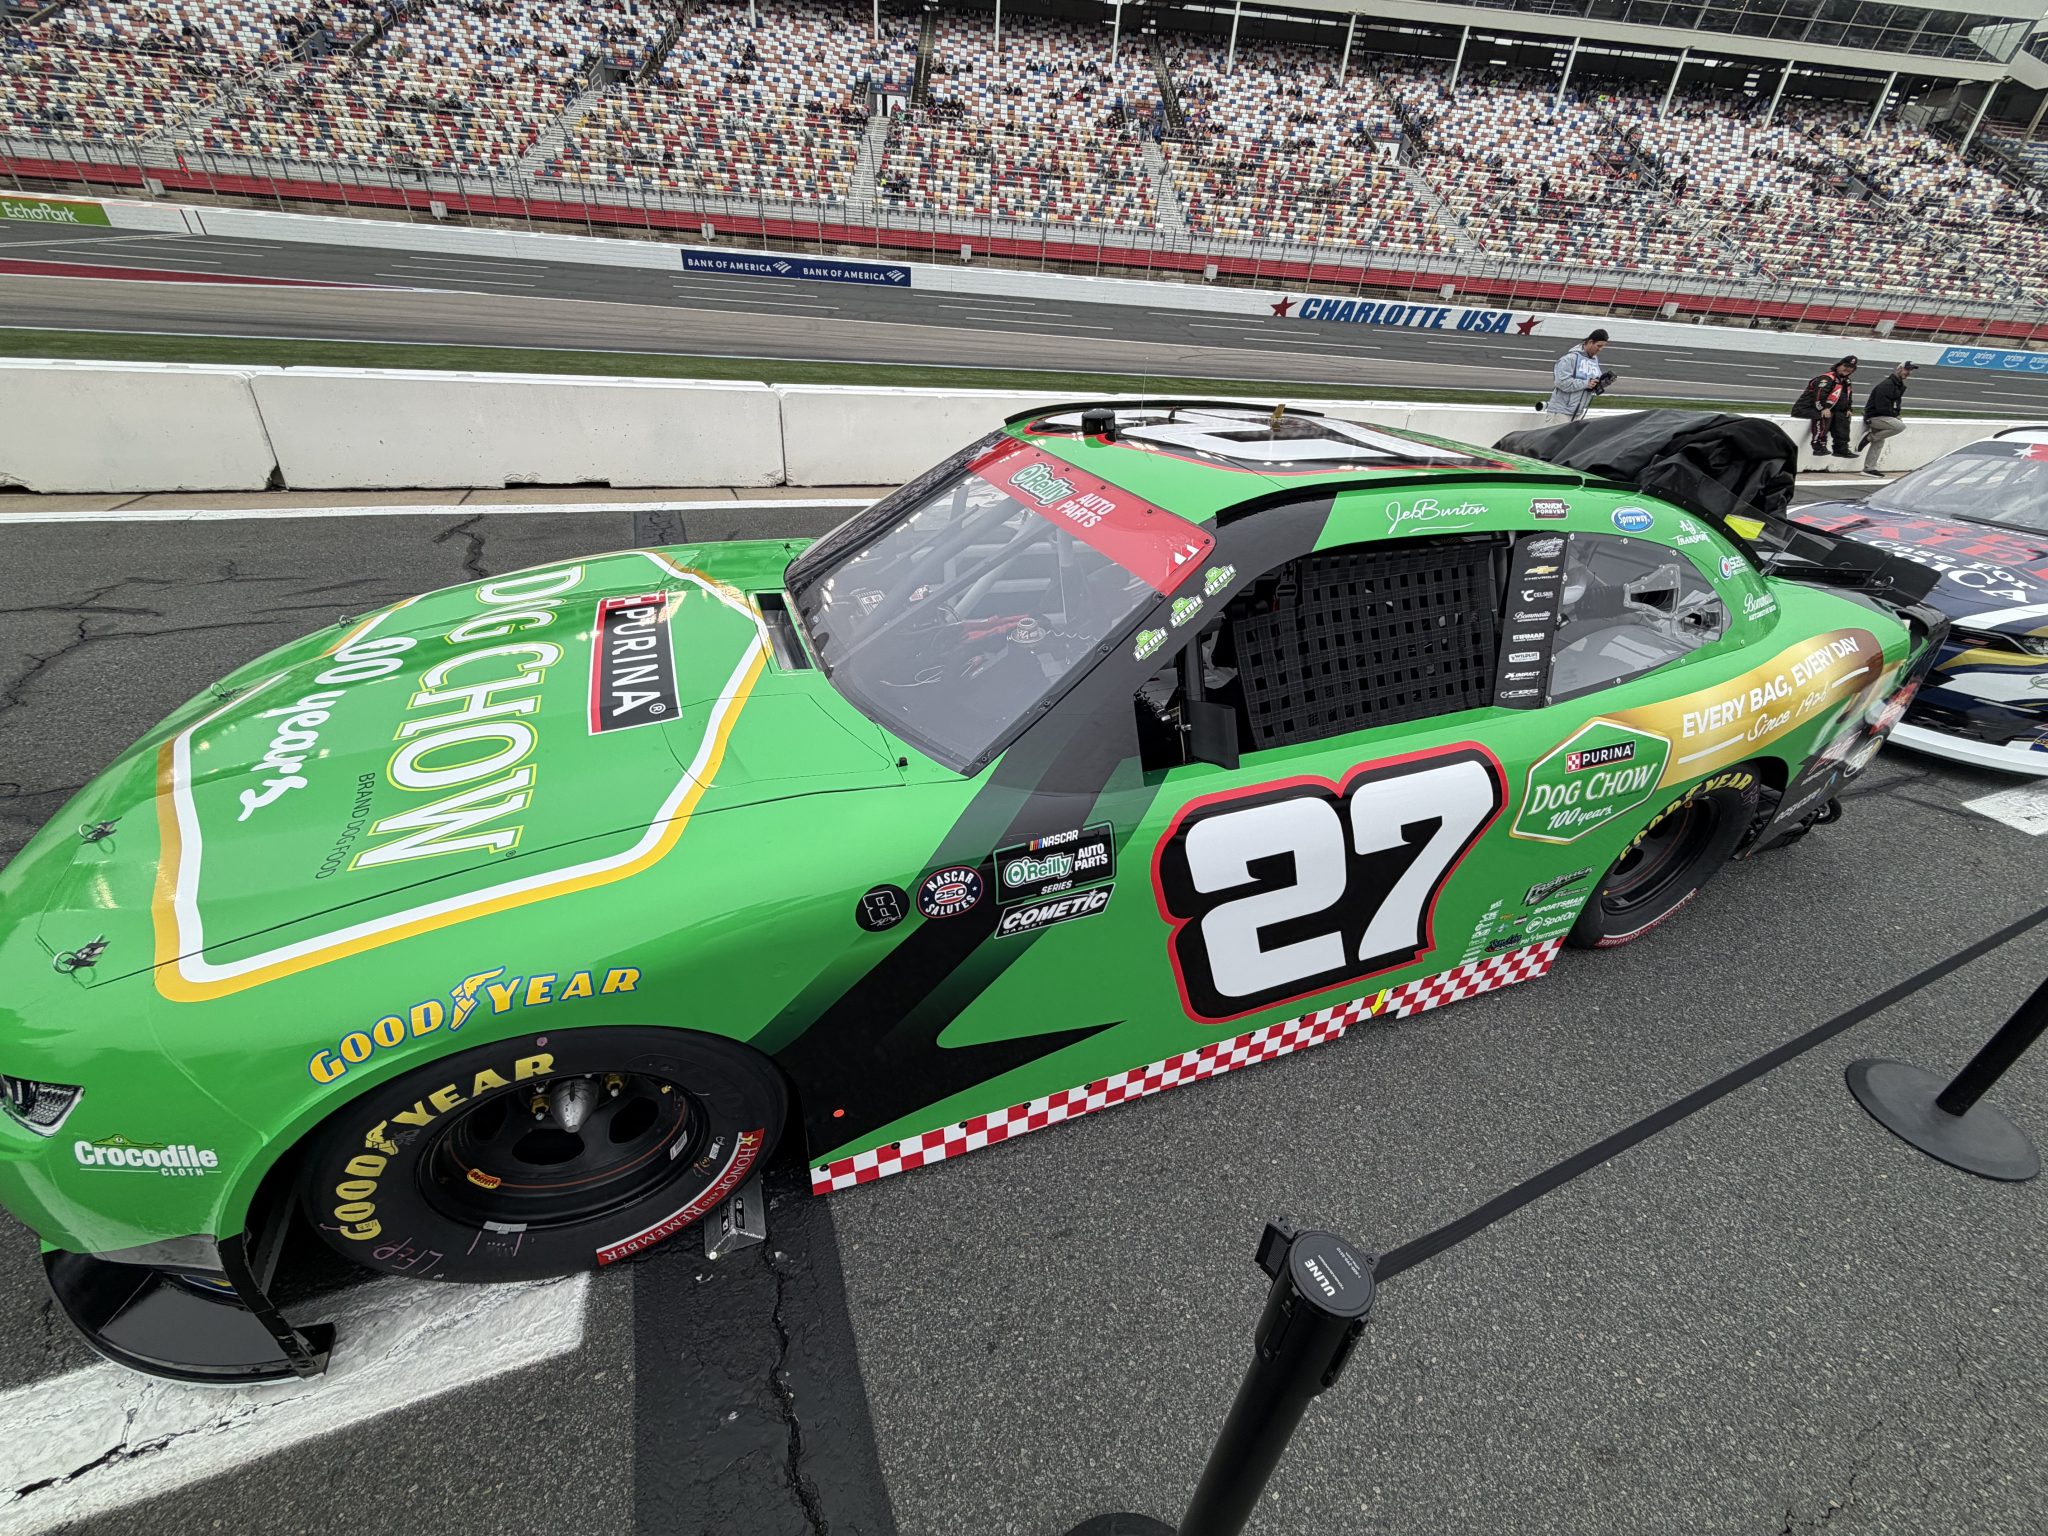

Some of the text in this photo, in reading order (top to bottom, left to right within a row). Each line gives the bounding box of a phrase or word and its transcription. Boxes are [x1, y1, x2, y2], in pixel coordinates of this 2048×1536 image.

[1, 202, 79, 224] EchoPark
[687, 258, 772, 273] BANK OF AMERICA
[803, 267, 886, 282] BANK OF AMERICA
[1299, 298, 1513, 335] CHARLOTTE USA
[1009, 462, 1076, 507] O'Reilly
[1056, 500, 1103, 528] PARTS
[1076, 493, 1117, 516] AUTO
[1617, 513, 1648, 525] Sprayway
[611, 605, 662, 717] PURINA
[1682, 636, 1861, 739] EVERY BAG, EVERY DAY
[237, 636, 418, 822] 00 years
[347, 564, 586, 872] DG CHOW
[1747, 711, 1791, 742] Since
[1581, 744, 1632, 766] PURINA
[351, 772, 376, 819] BRAND
[1527, 762, 1659, 817] DOG CHOW
[1546, 804, 1614, 831] 100 years
[1042, 829, 1079, 849] NASCAR
[1077, 843, 1105, 860] AUTO
[1007, 854, 1073, 887] O'Reilly
[1074, 854, 1108, 871] PARTS
[926, 870, 975, 892] NASCAR
[1040, 880, 1073, 895] SERIES
[1185, 760, 1494, 998] 27
[925, 894, 976, 916] SALUTES
[936, 887, 966, 900] 250
[1002, 891, 1109, 930] COMETIC
[1542, 911, 1576, 927] SpotOn
[1003, 921, 1044, 935] GASKET
[74, 1140, 219, 1168] Crocodile
[161, 1167, 205, 1177] CLOTH
[717, 1146, 759, 1192] HONOR
[701, 1192, 721, 1208] AND
[601, 1203, 705, 1262] REMEMBER
[1304, 1258, 1336, 1297] ULINE
